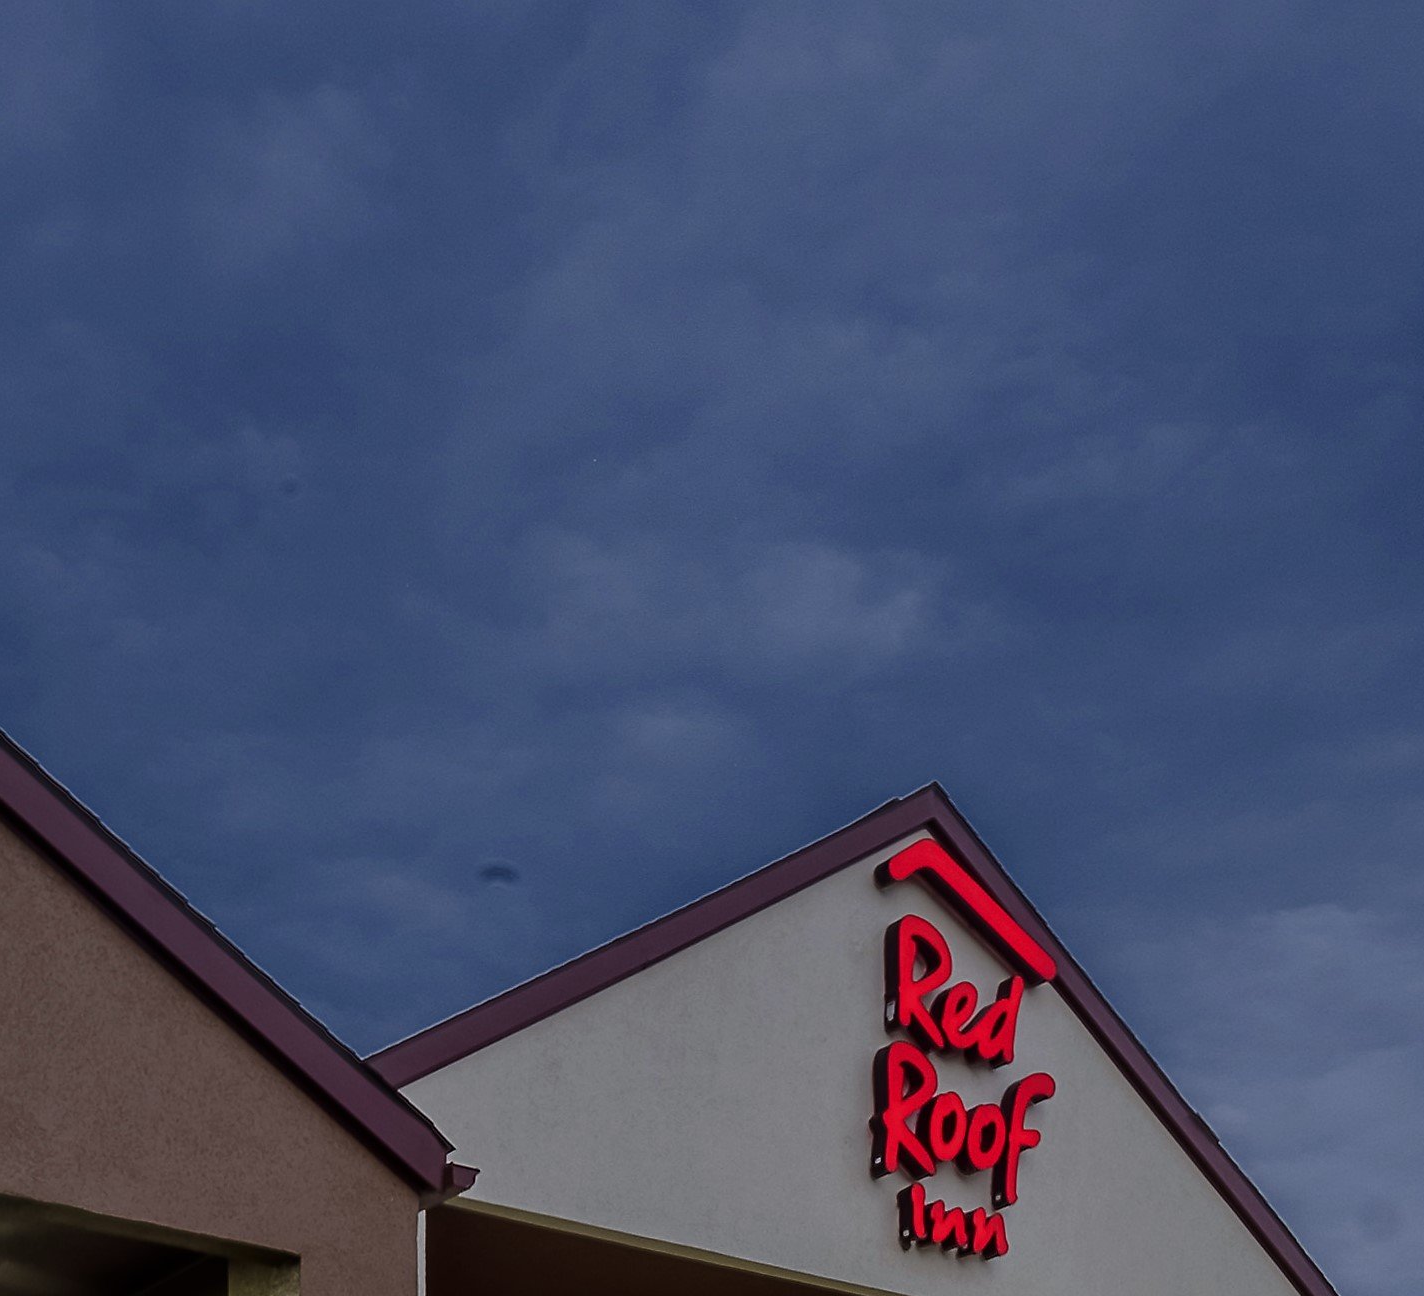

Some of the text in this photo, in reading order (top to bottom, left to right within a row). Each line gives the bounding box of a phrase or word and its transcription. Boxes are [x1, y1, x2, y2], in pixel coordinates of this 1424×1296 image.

[886, 914, 1024, 1067] Red
[872, 1041, 1055, 1207] Roof
[899, 1183, 1009, 1258] Inn
